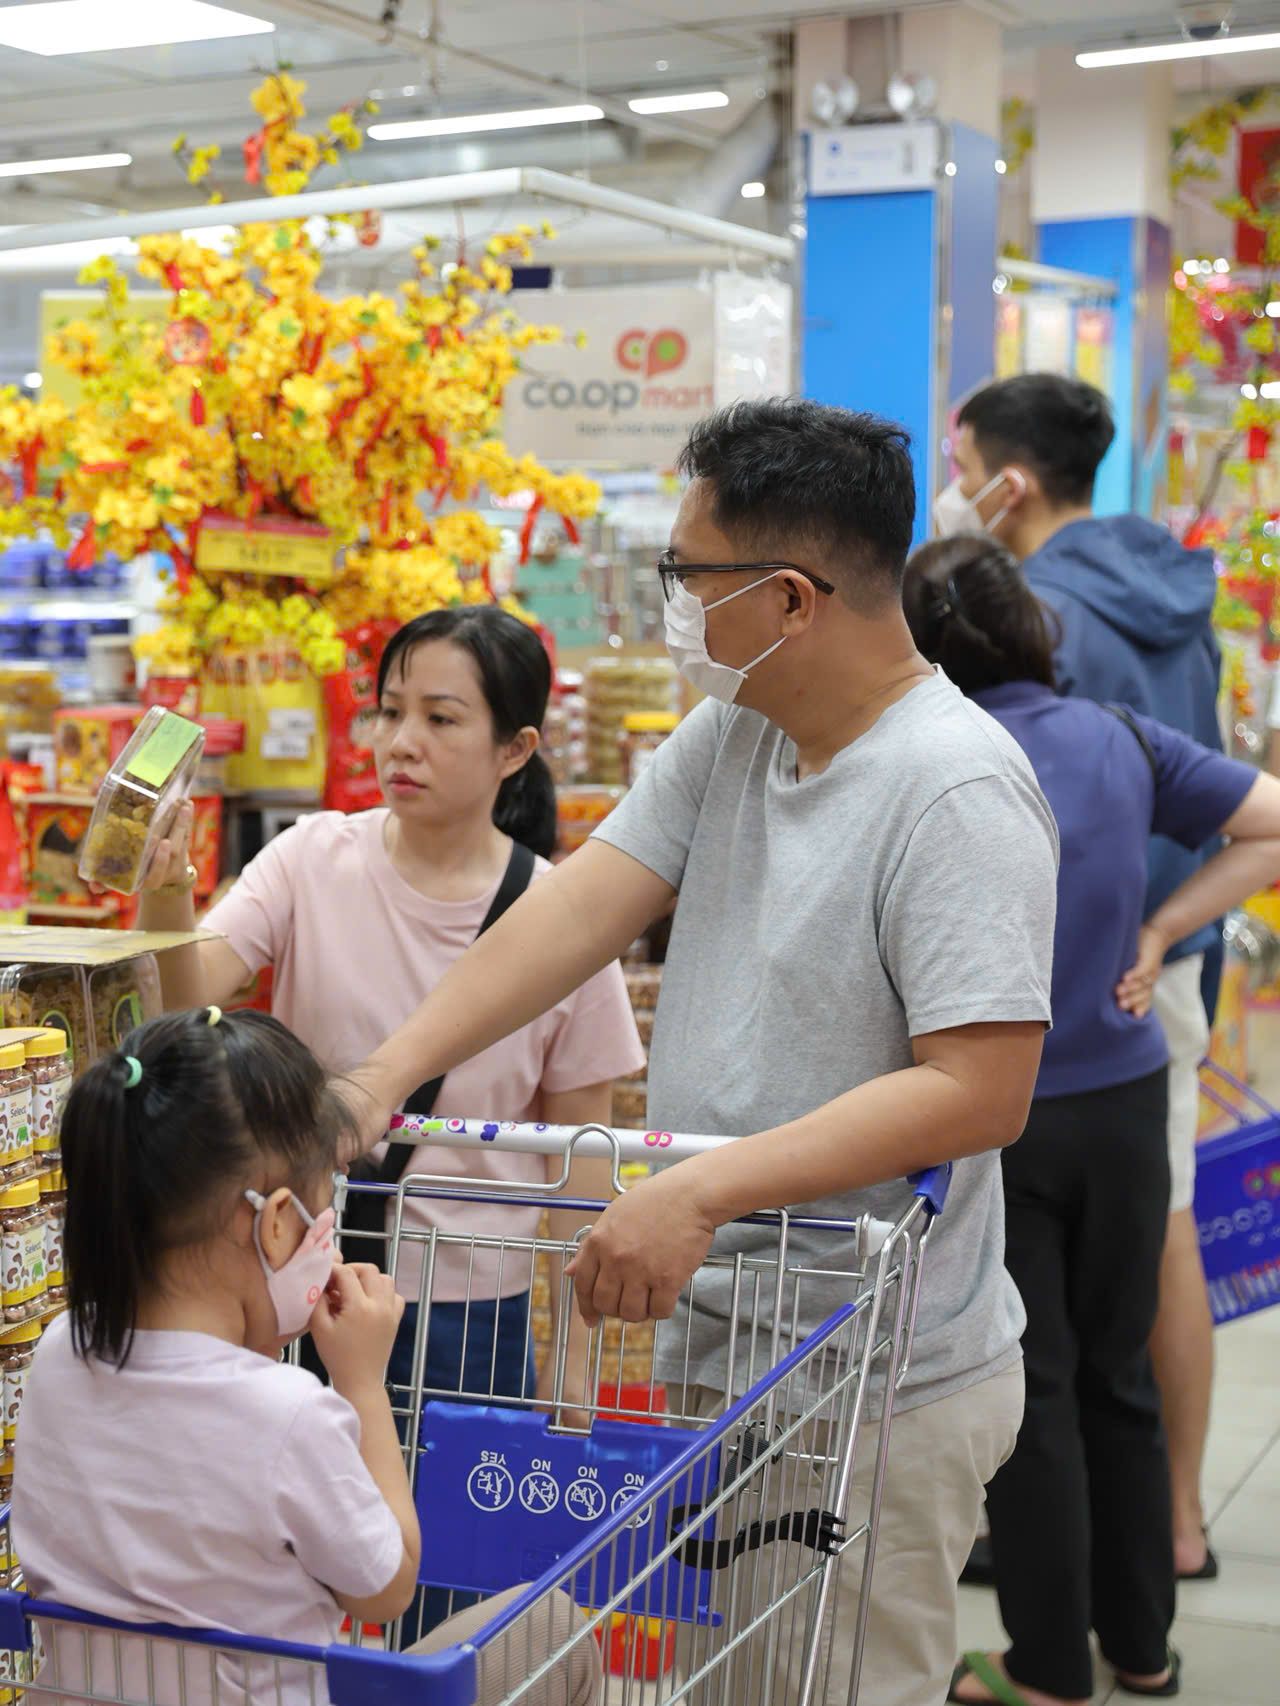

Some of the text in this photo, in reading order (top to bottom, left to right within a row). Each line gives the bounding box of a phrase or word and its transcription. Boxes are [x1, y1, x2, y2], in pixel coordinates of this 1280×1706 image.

[11, 1106, 27, 1119] Select
[25, 1242, 42, 1255] Select
[480, 1450, 507, 1465] YES
